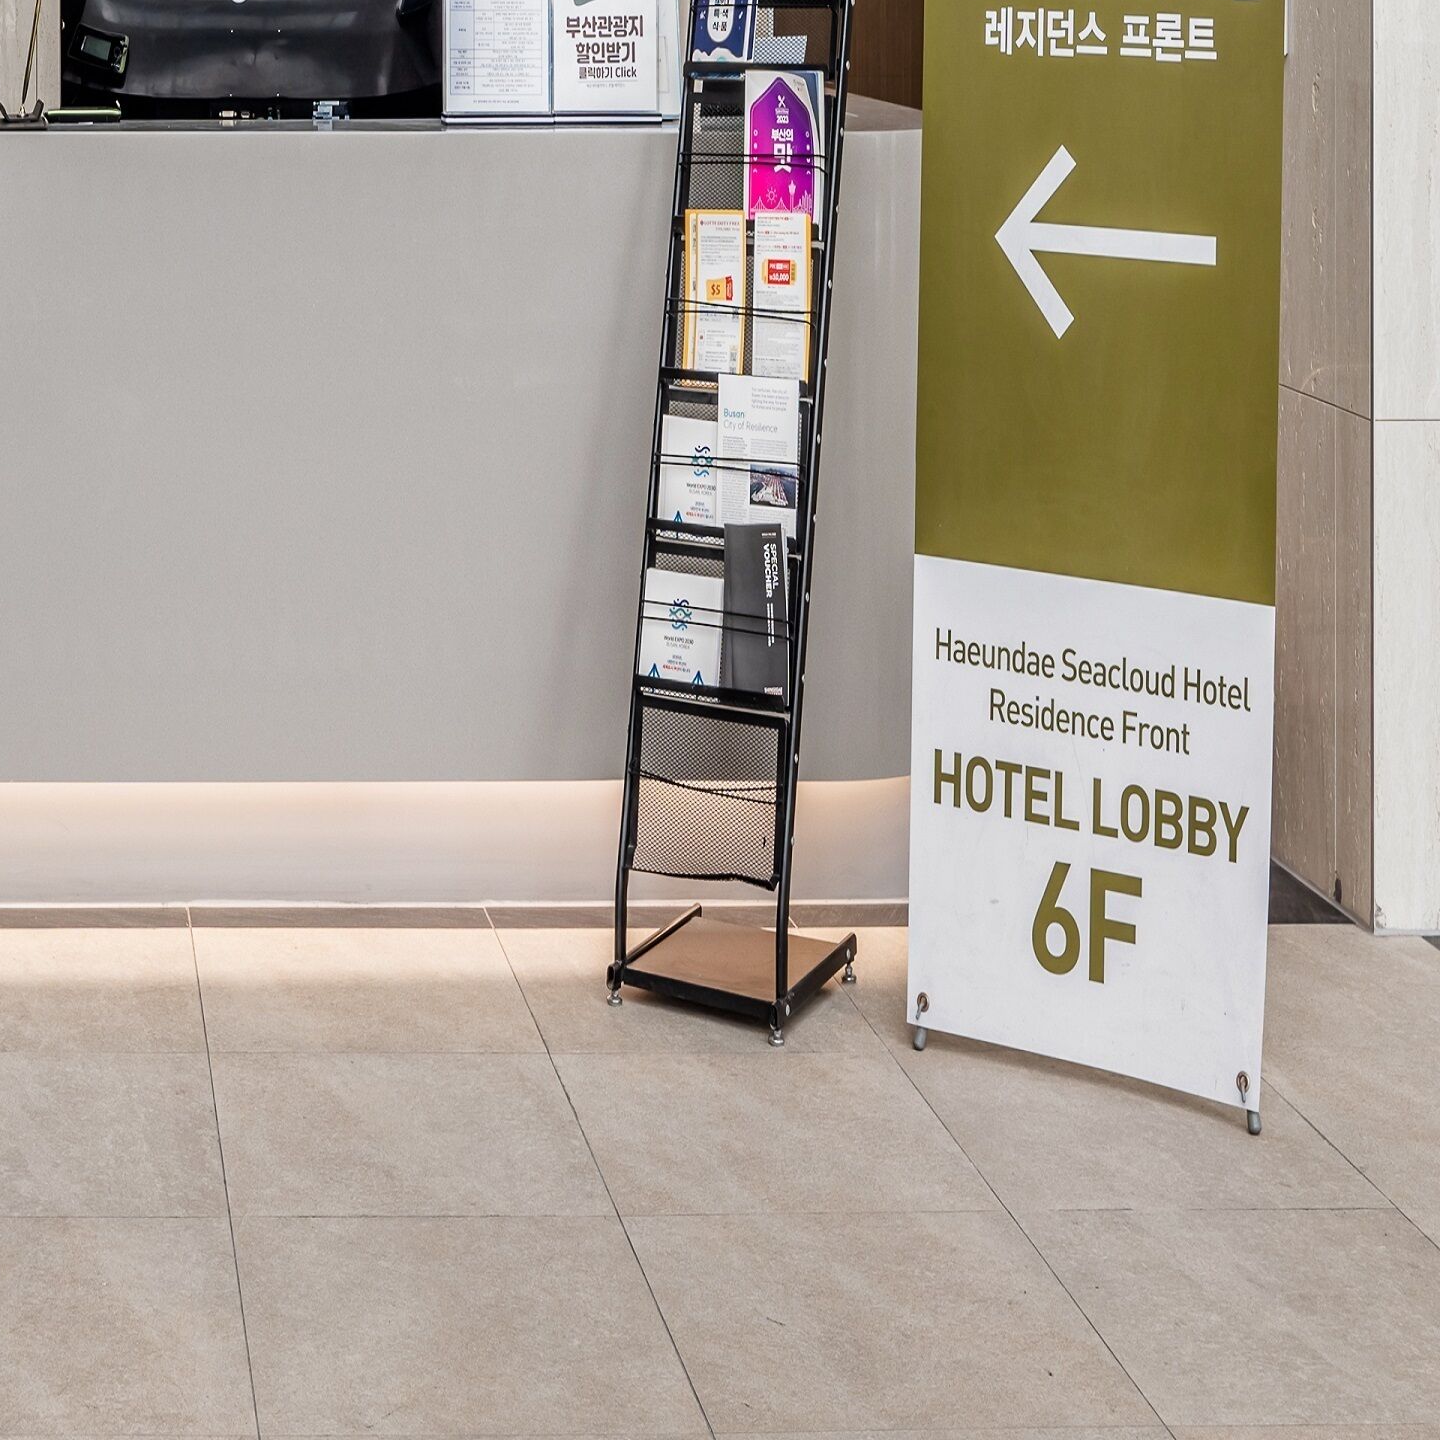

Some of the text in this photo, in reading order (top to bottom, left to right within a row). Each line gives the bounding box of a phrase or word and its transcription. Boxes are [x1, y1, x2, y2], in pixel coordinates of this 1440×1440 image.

[566, 15, 644, 38] 부산관광지
[985, 6, 1217, 62] 레지던스 프론트
[576, 42, 636, 64] 할인받기
[615, 65, 637, 78] Click
[771, 128, 794, 141] 부산의
[723, 408, 745, 418] Busan
[723, 420, 736, 432] City
[763, 543, 773, 598] VOUCHER
[769, 543, 779, 590] SPECIAL
[935, 627, 1251, 712] Haeundae Seacloud Hotel
[989, 688, 1190, 755] Residence Front
[933, 748, 1250, 864] HOTEL LOBBY
[1031, 861, 1143, 984] 6F
